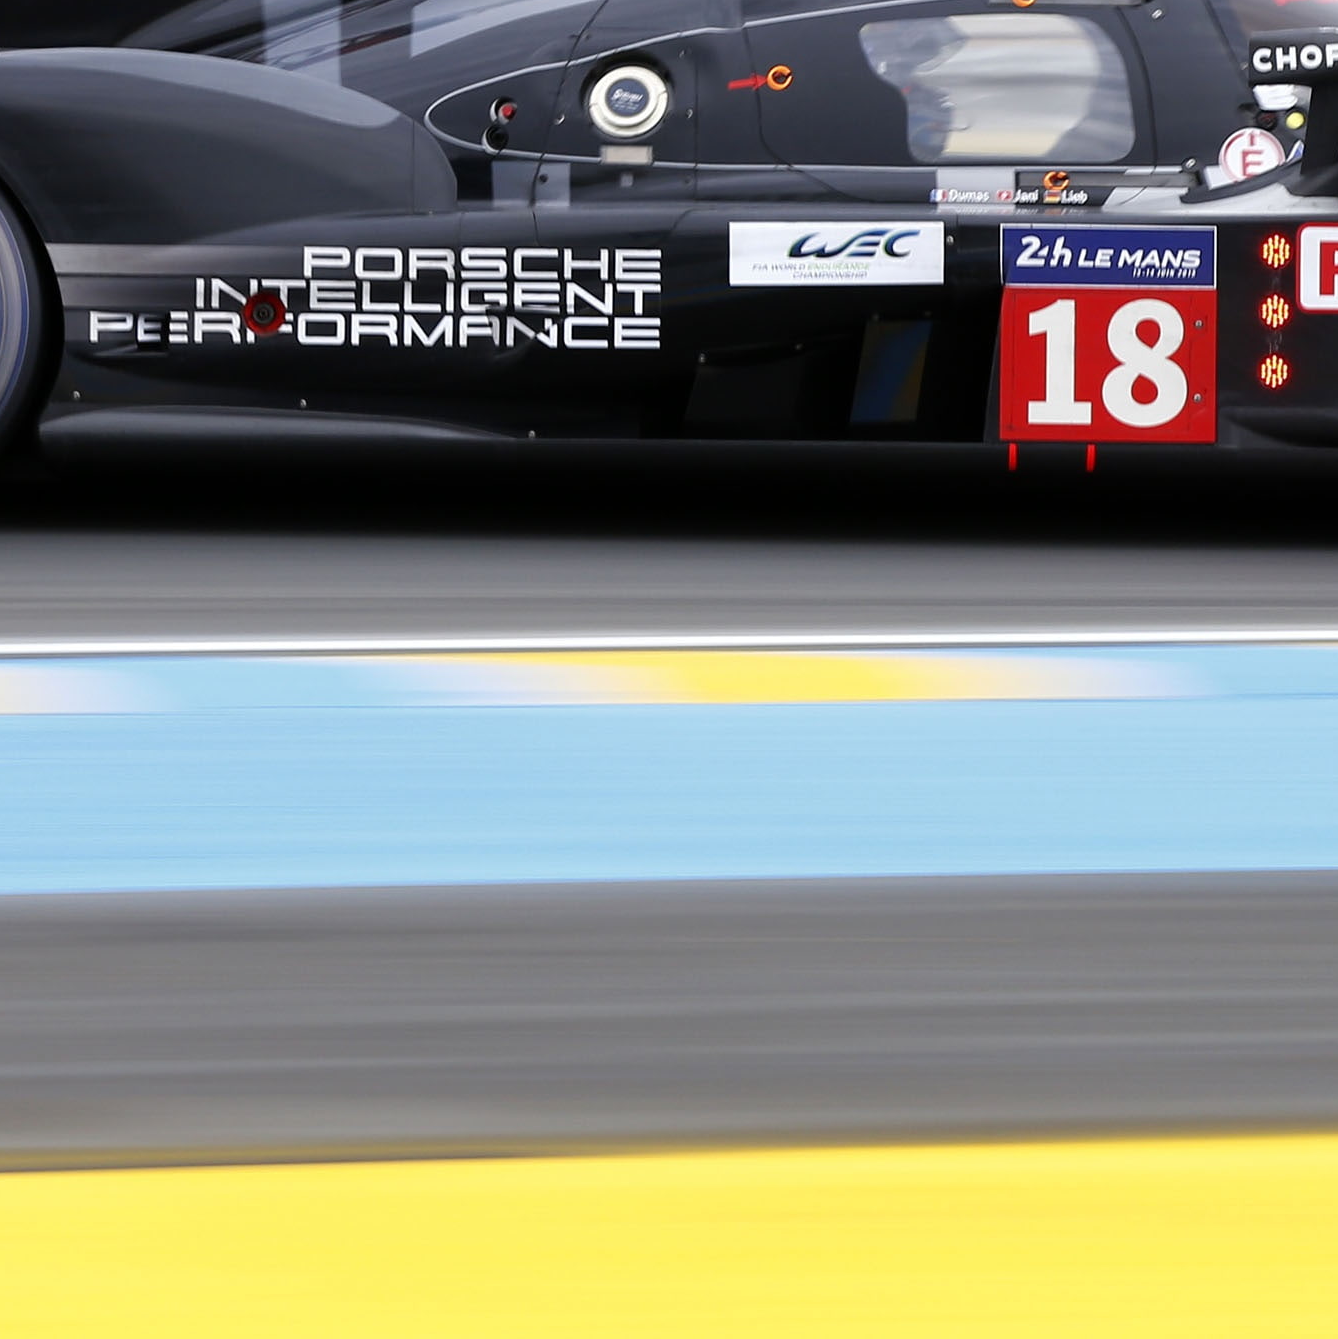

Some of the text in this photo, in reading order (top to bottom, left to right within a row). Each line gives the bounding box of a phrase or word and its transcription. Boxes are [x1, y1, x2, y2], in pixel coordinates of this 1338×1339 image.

[948, 188, 990, 203] Dumas
[1012, 188, 1039, 204] Jani
[1061, 189, 1089, 205] Lieb
[787, 227, 921, 259] WEC
[303, 245, 661, 281] PORSCHE
[1077, 248, 1114, 268] LE
[1117, 249, 1201, 269] MANS
[195, 277, 661, 316] INTELLIGENT
[1027, 298, 1189, 429] 18
